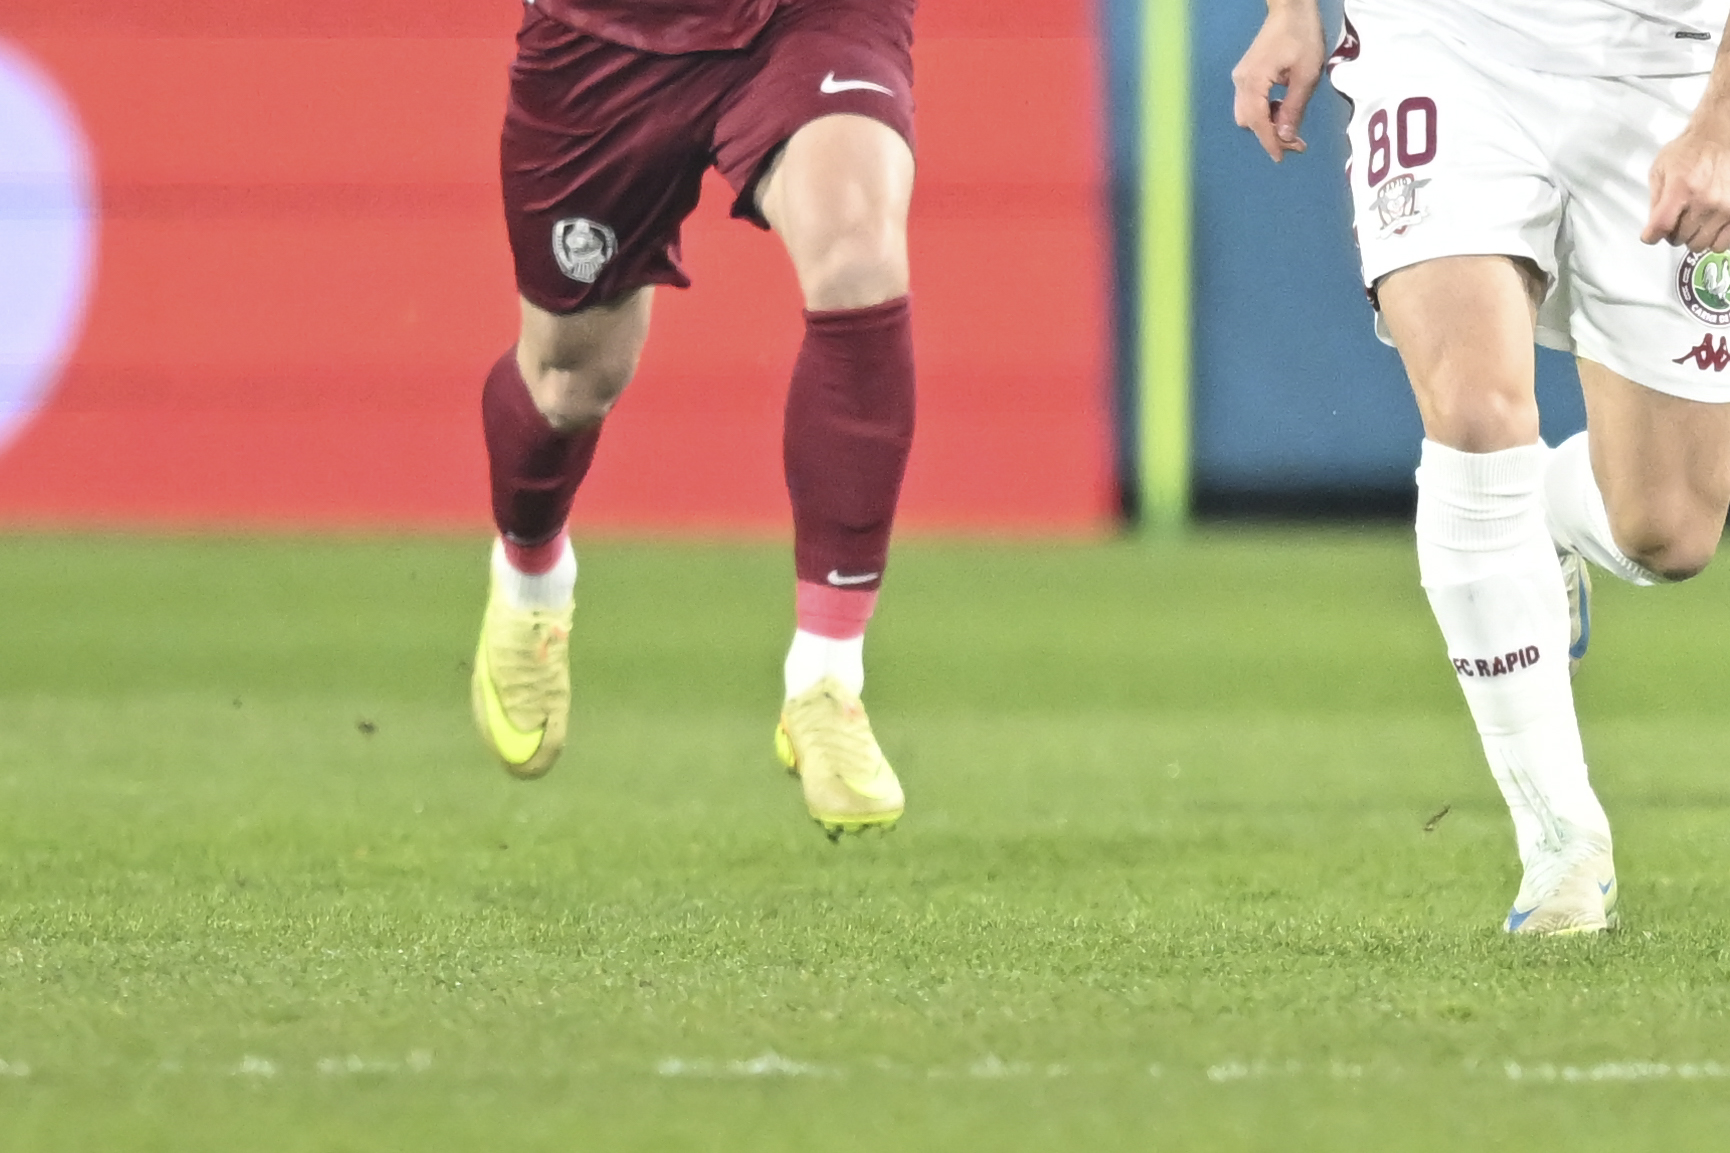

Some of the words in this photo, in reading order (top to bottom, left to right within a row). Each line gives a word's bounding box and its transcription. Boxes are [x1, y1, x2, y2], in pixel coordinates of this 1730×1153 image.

[1367, 96, 1438, 187] 80
[1452, 657, 1474, 677] FC
[1475, 645, 1540, 677] RAPID
